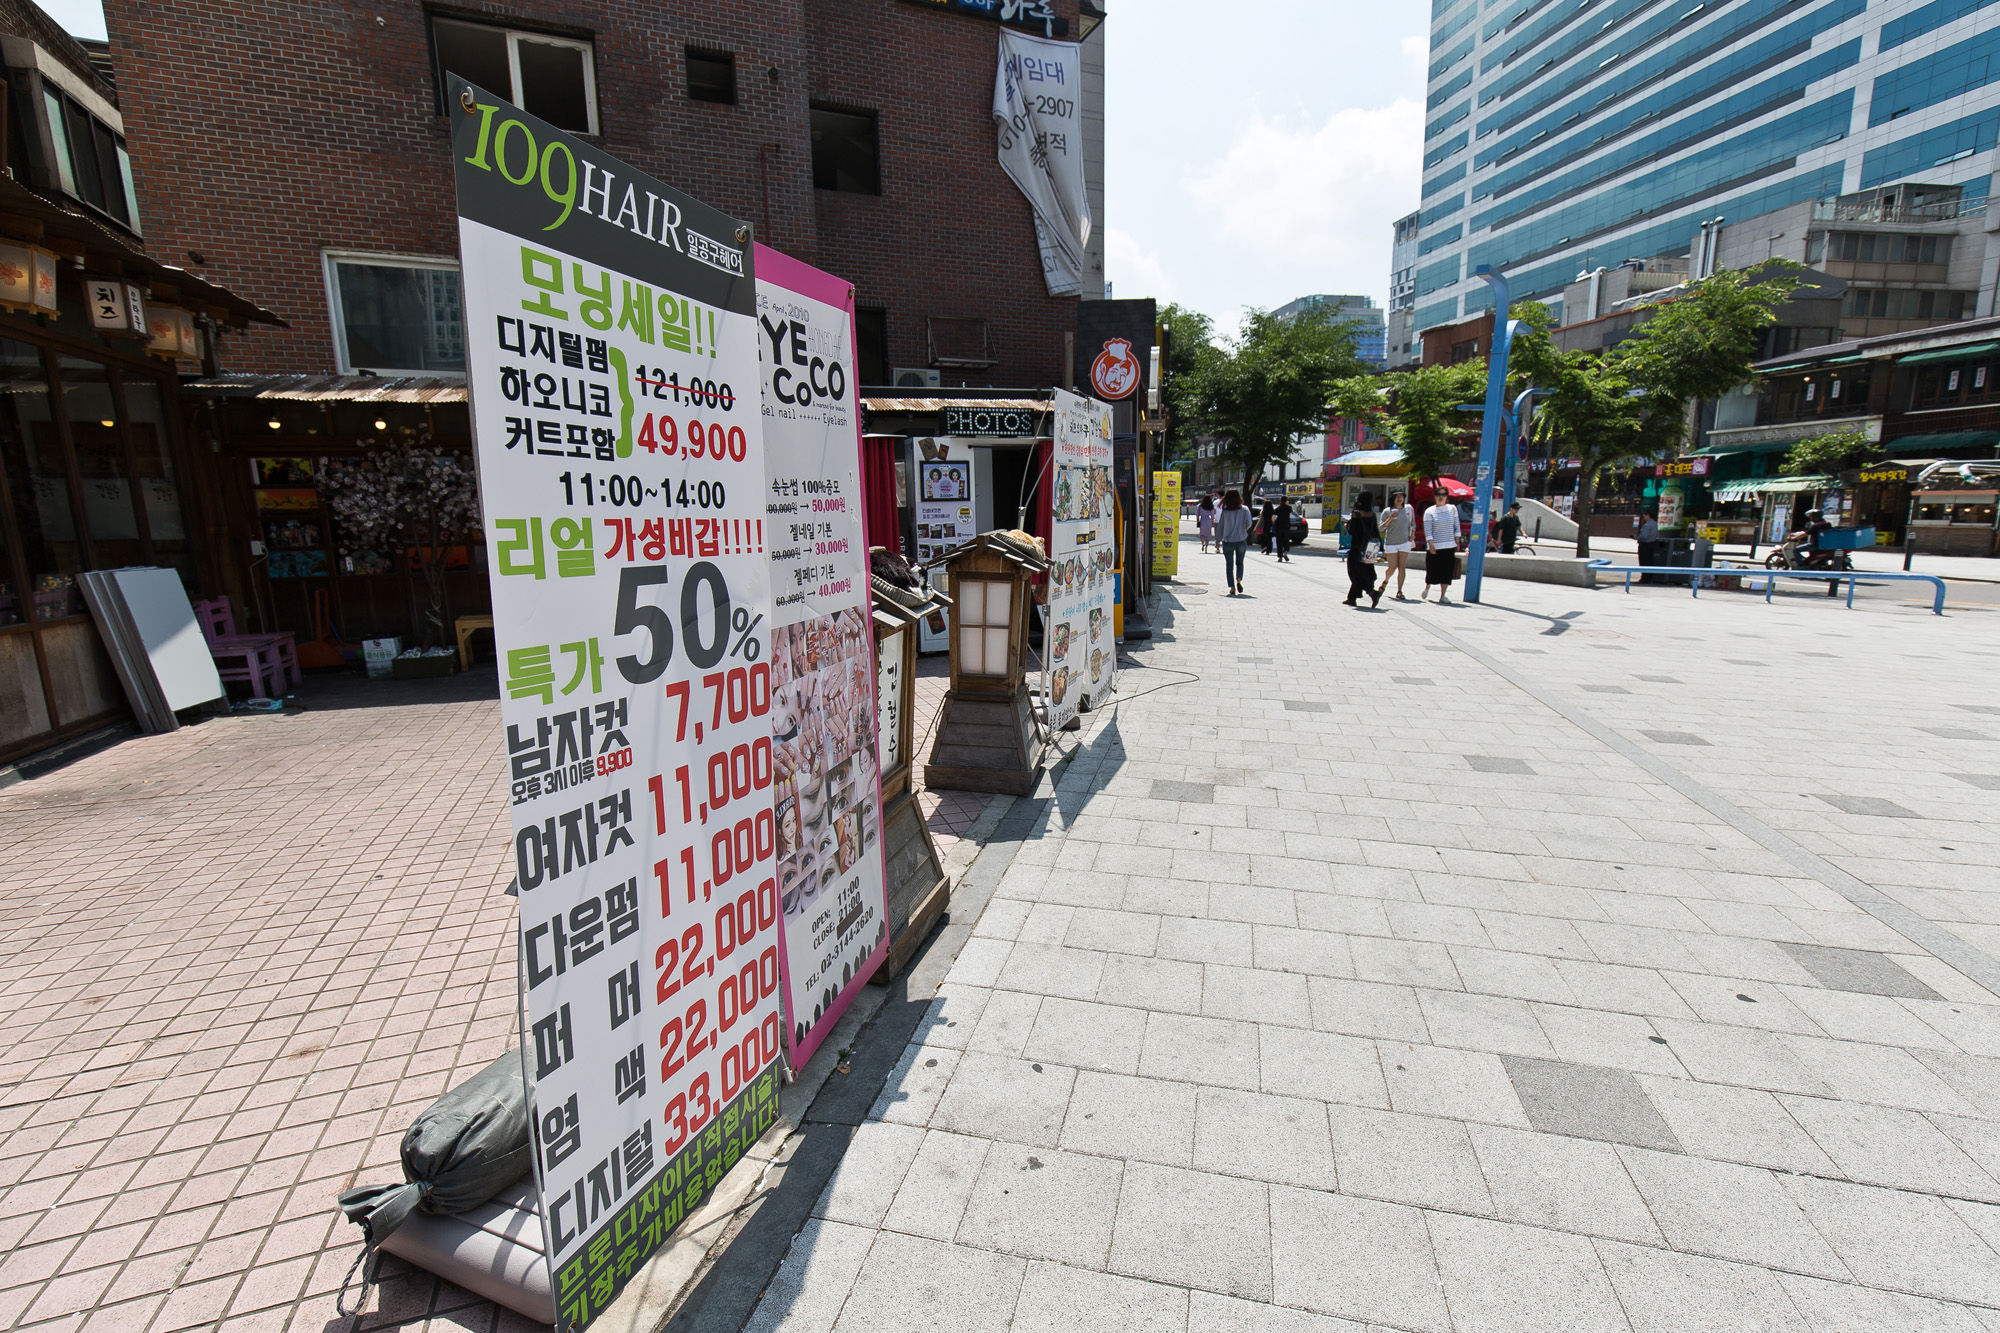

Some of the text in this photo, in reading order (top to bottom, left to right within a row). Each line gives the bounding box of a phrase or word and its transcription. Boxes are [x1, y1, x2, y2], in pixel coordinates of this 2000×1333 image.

[687, 233, 743, 274] 일공구헤어
[521, 246, 717, 359] 모닝세일!!
[497, 315, 609, 374] 디지털펌
[757, 313, 808, 367] YE
[500, 366, 613, 418] 하오니코
[634, 365, 736, 412] 121,000
[505, 416, 616, 462] 커트포함
[637, 413, 747, 463] 49,900
[761, 404, 848, 427] Gel nail Eyelash
[946, 411, 1032, 431] PHOTOS
[559, 471, 726, 509] 11:00~14:00
[772, 478, 798, 496] 속눈썹
[812, 497, 846, 513] 50,000원
[495, 517, 763, 580] 리얼 가성비갑!!!!
[789, 521, 833, 541] 젤네일 기본
[815, 537, 849, 556] 30,000원
[793, 563, 836, 586] 젤페디 기본
[818, 577, 851, 598] 40,000원
[506, 637, 604, 705] 특가
[507, 662, 770, 781] 남자컷 7,700
[511, 776, 542, 806] 오후
[596, 747, 633, 778] 9,900
[516, 735, 773, 892] 여자컷 11,000
[525, 807, 774, 991] 다운펌 11,000
[837, 876, 860, 906] 11:00
[655, 876, 777, 1005] 22,000
[820, 905, 874, 974] 02-3144-2620
[660, 944, 777, 1084] 22,000
[549, 1010, 780, 1259] 디지털 33,000
